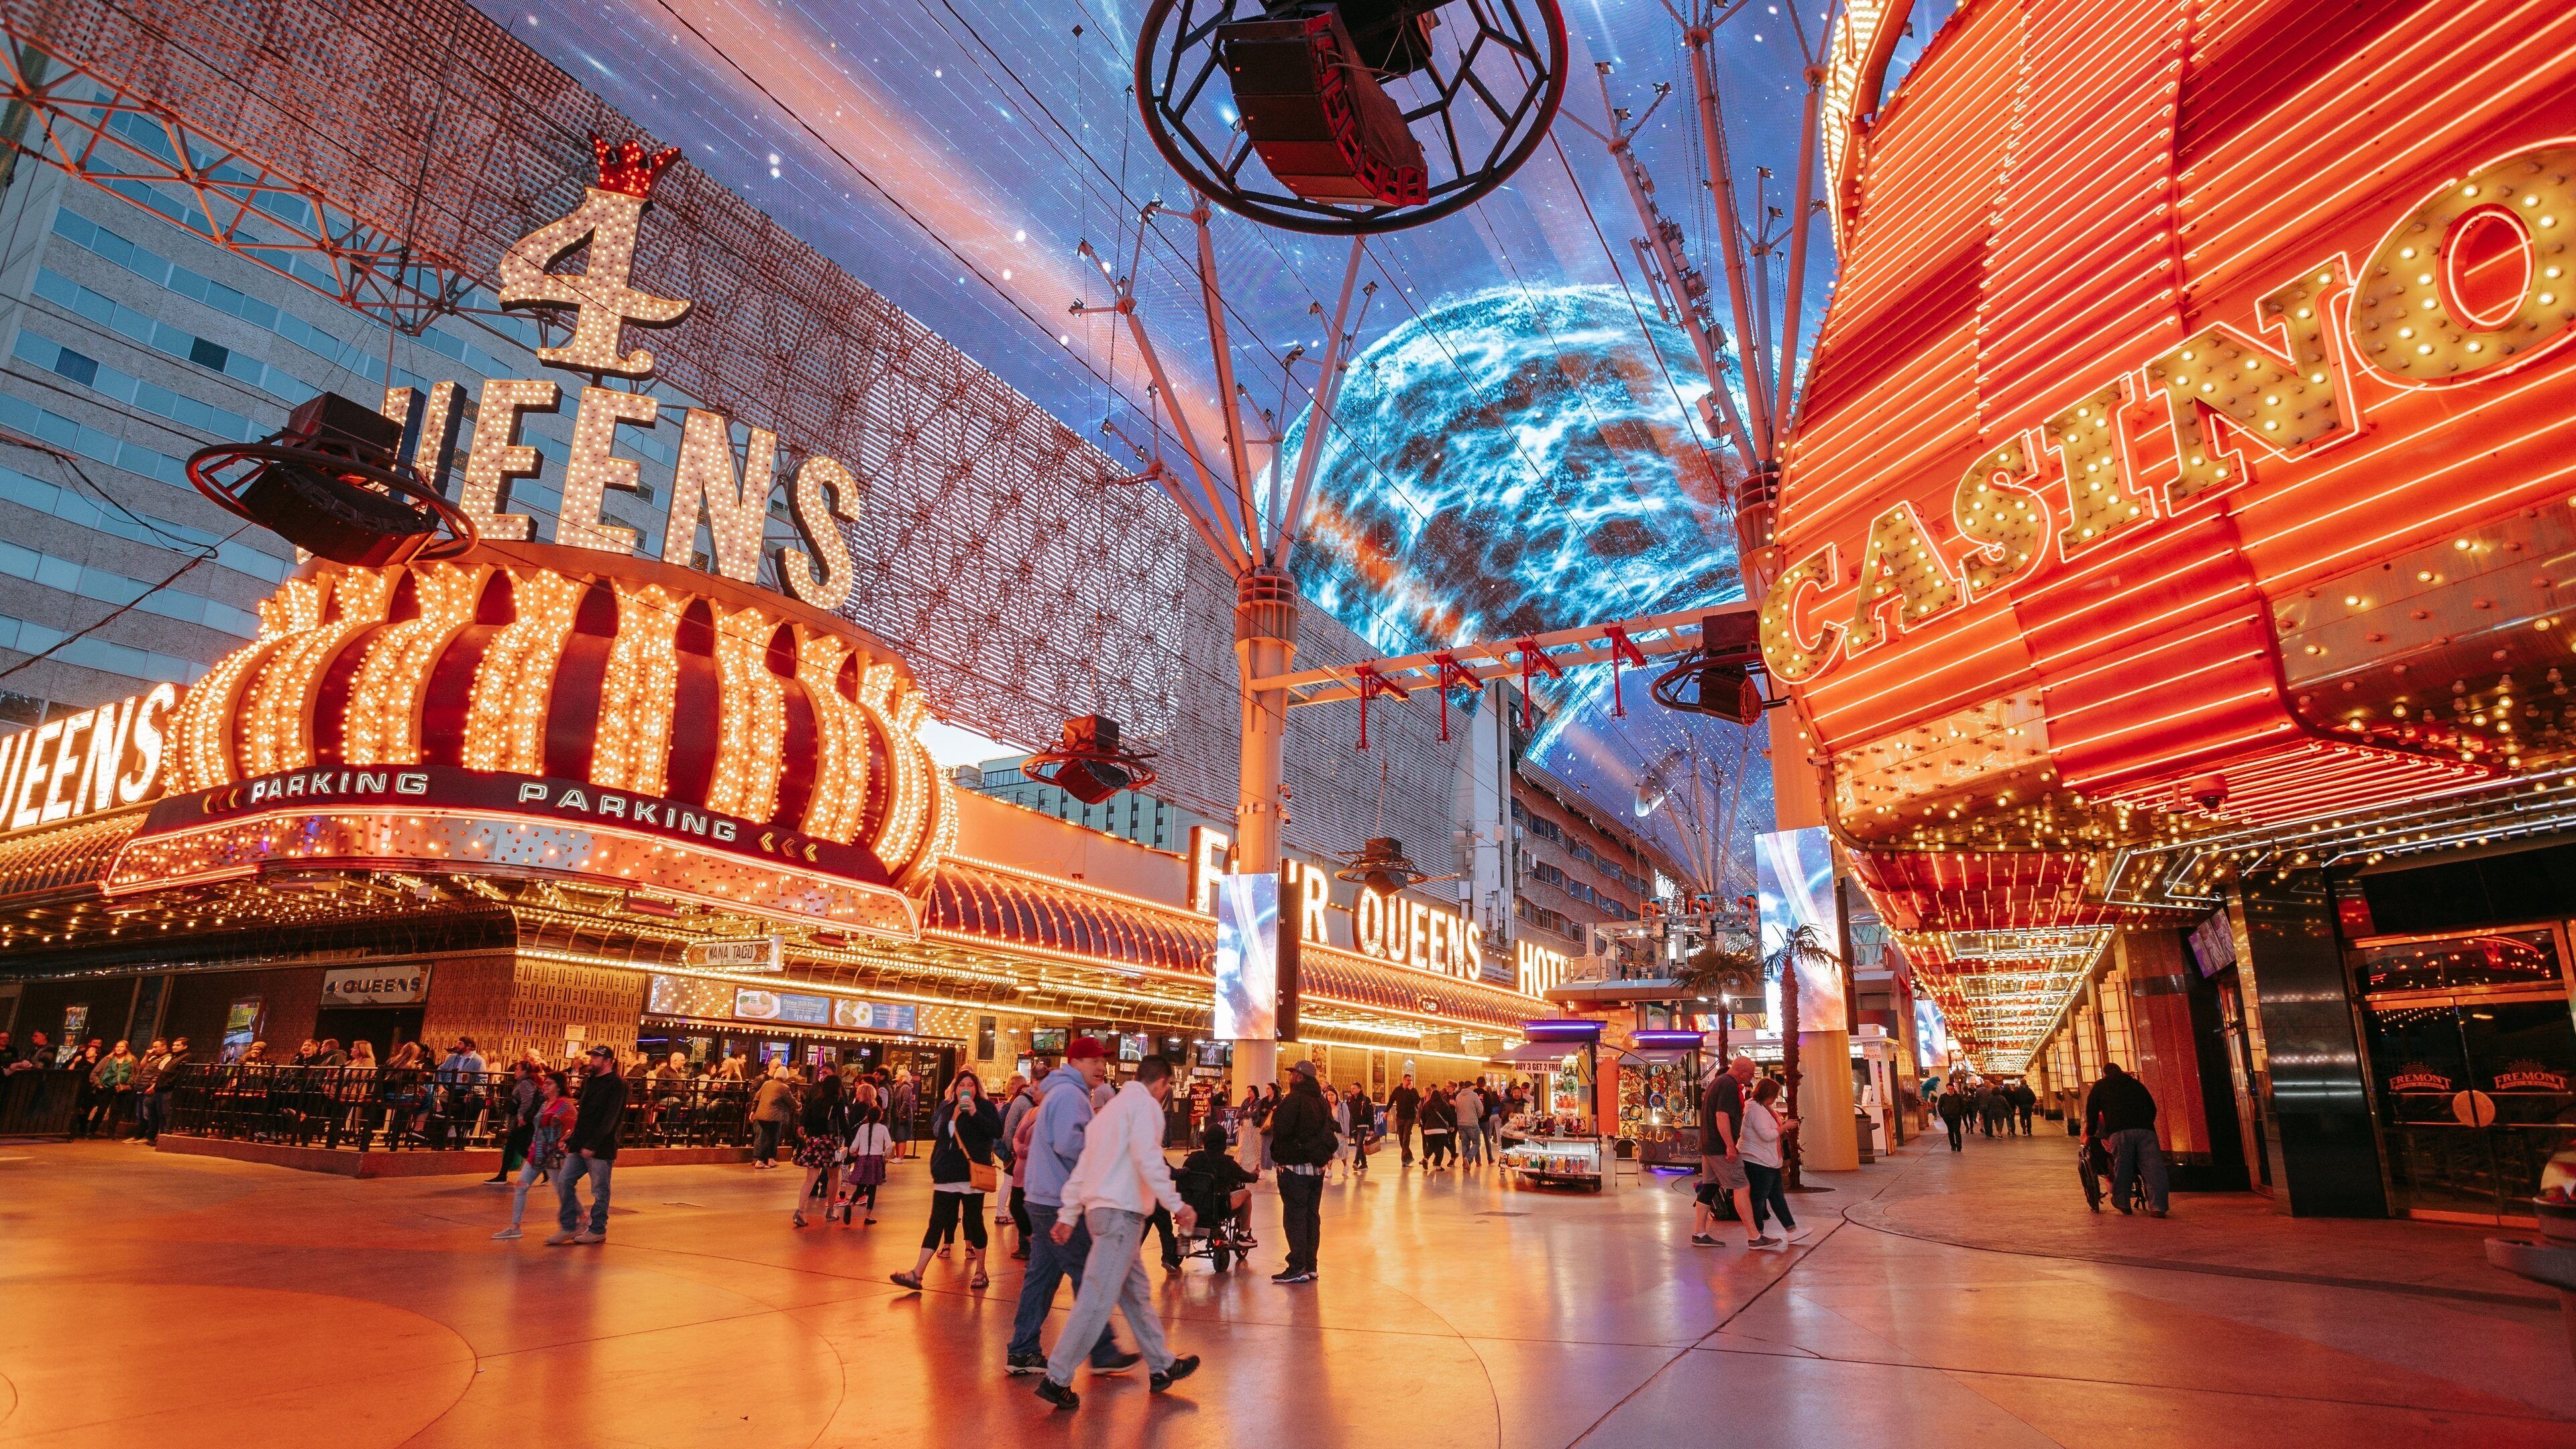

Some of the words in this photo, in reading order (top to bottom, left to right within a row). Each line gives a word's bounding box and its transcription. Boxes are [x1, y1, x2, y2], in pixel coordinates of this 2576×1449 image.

[499, 187, 694, 379] 4
[1760, 136, 2576, 686] CASINO
[382, 380, 860, 610] UEENS
[250, 771, 429, 804] PARKING
[517, 782, 737, 843] PARKING
[708, 944, 729, 961] WANA
[1356, 885, 1481, 981] QUEENS
[326, 981, 339, 994] 4
[2389, 1074, 2452, 1090] FREMONT
[2493, 1072, 2567, 1089] FREMONT
